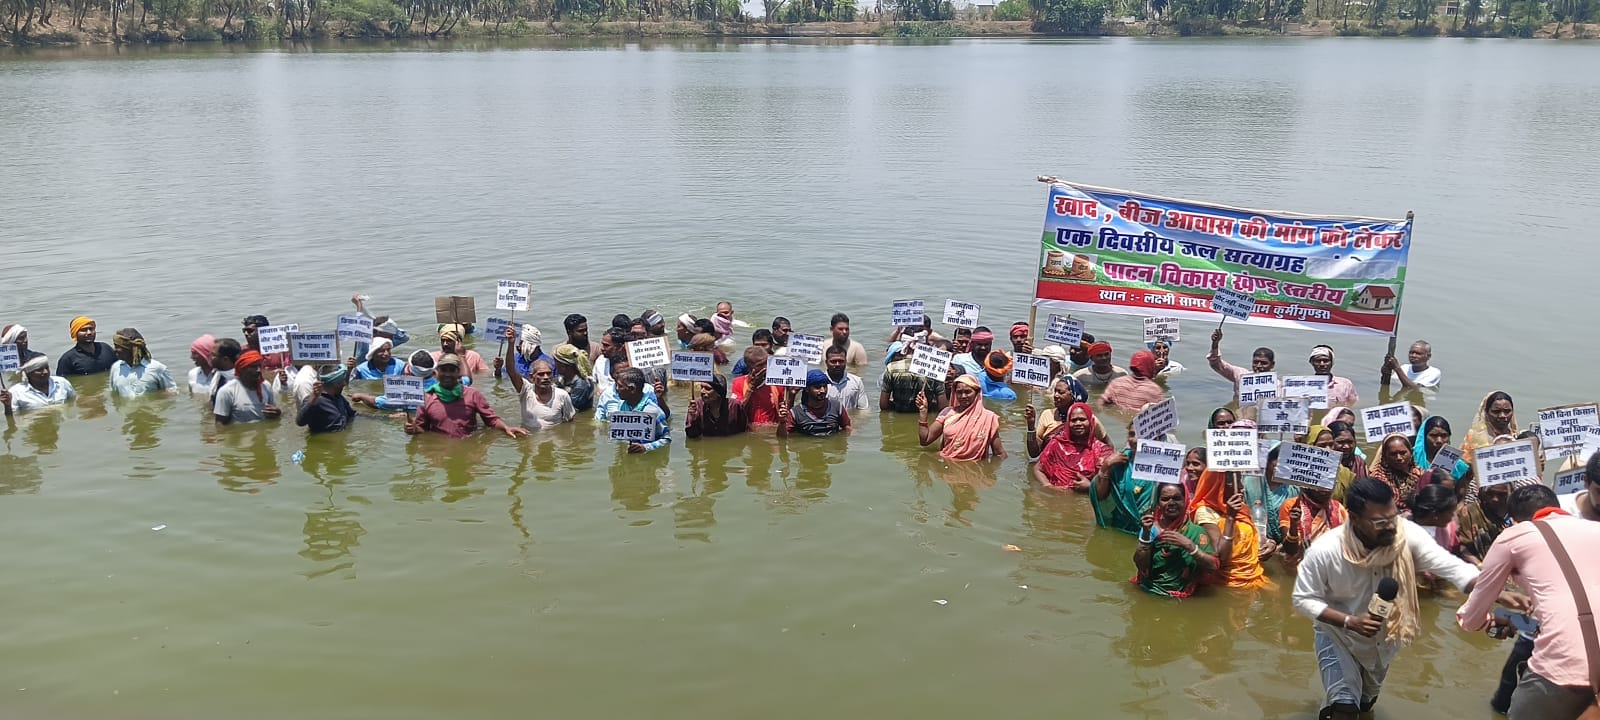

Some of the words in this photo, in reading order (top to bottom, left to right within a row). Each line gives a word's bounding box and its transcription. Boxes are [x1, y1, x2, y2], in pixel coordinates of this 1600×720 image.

[1056, 197, 1098, 218] खाद
[1118, 201, 1162, 225] बीज
[1164, 211, 1235, 235] आवास
[1239, 217, 1271, 239] की
[1274, 223, 1316, 245] मांग
[1321, 226, 1350, 247] को
[1354, 228, 1405, 250] लेकर
[1057, 228, 1094, 246] एक
[1098, 227, 1174, 254] दिवसीय
[1179, 241, 1220, 260] जल
[1224, 249, 1307, 273] सत्याग्रह
[1104, 263, 1156, 283] पाटन
[1159, 263, 1228, 288] विकास
[1283, 284, 1347, 305] स्तरीय
[1099, 290, 1127, 302] स्थान
[1179, 296, 1207, 308] सागर
[1017, 354, 1028, 364] जय
[1015, 369, 1026, 379] जय
[1027, 368, 1048, 383] किसान
[1242, 377, 1254, 386] जय
[1241, 392, 1253, 402] जय
[611, 415, 641, 423] आवाज
[643, 414, 653, 425] दो
[1276, 411, 1288, 420] और
[1365, 409, 1381, 420] जय
[1541, 411, 1555, 420] खेती
[1556, 410, 1572, 418] बिना
[1572, 408, 1596, 416] किसान
[611, 429, 625, 438] हम
[627, 429, 643, 438] एक
[1368, 426, 1382, 437] जय
[1383, 421, 1411, 434] किसान
[1545, 428, 1556, 436] देश
[1135, 463, 1153, 473] एकता
[1154, 464, 1180, 476] जिंदाबाद
[1290, 474, 1318, 484] अधिकार
[1559, 474, 1573, 487] जय
